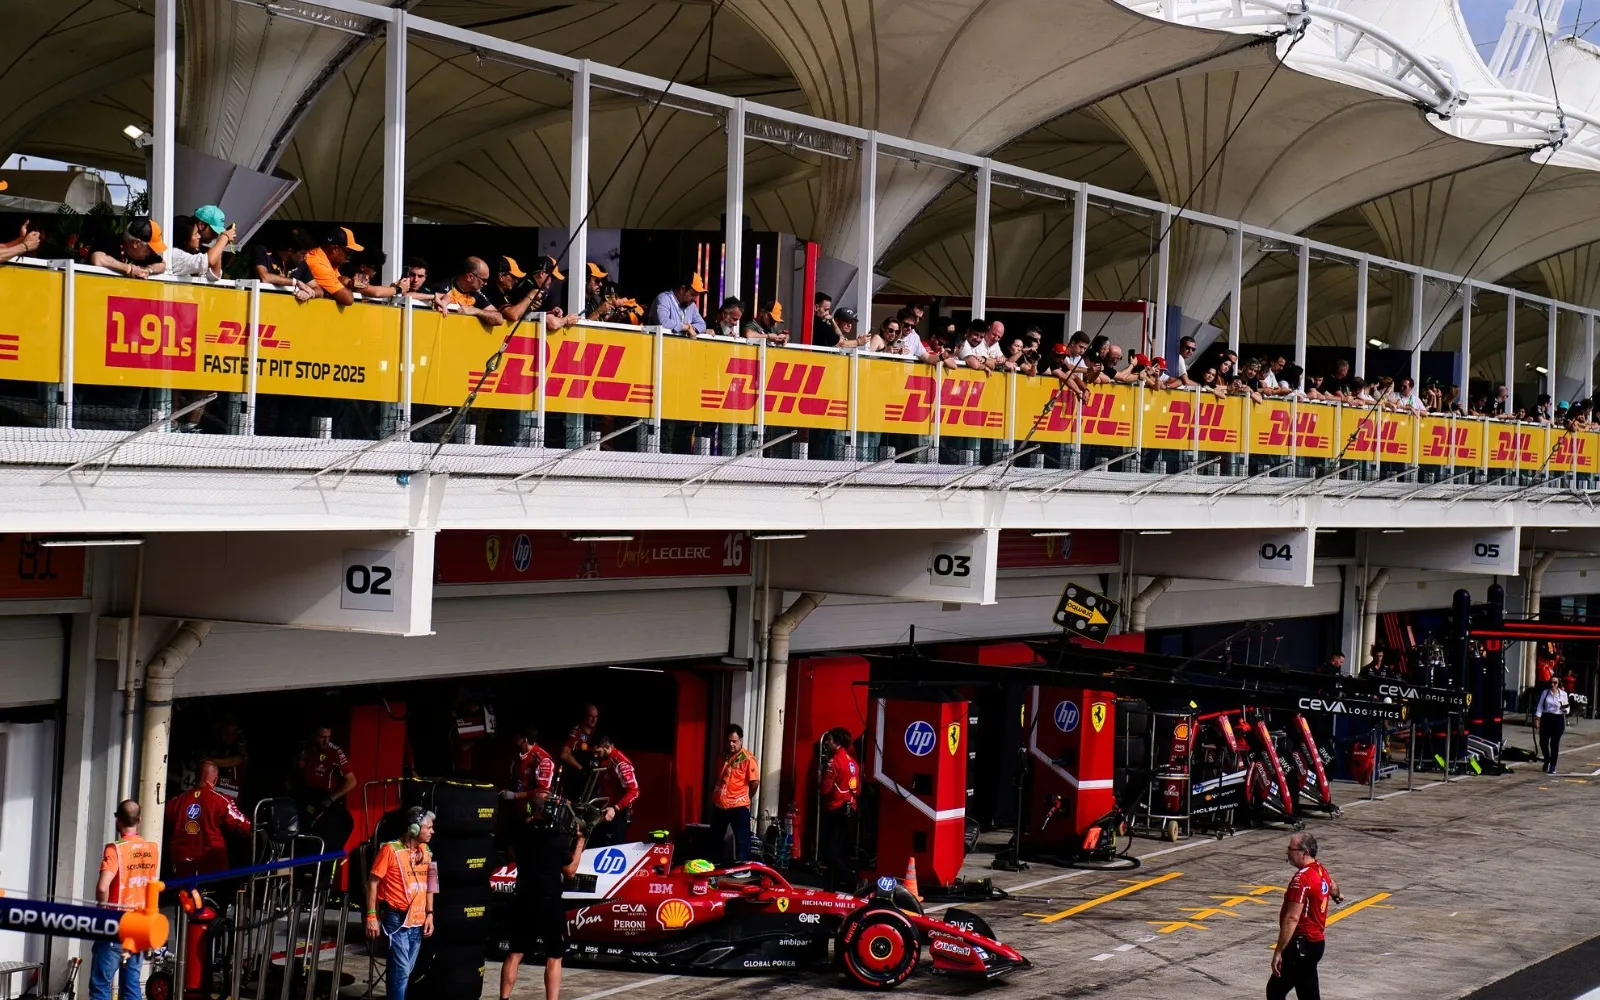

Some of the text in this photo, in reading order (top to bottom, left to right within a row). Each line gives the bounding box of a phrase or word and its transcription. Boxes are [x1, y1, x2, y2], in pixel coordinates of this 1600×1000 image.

[111, 311, 192, 357] 1.91s
[217, 321, 280, 348] DHL
[203, 354, 366, 383] FASTET PIT STOP 2025
[494, 334, 632, 400] DHL
[721, 358, 829, 415] DHL
[901, 375, 989, 426] DHL
[1045, 388, 1118, 434] DHL
[1167, 400, 1228, 442] DHL
[1268, 410, 1321, 448] DHL
[1355, 418, 1400, 454] DHL
[1430, 426, 1470, 459] DHL
[1497, 432, 1532, 463] DHL
[1556, 436, 1586, 466] DHL
[653, 547, 711, 560] LECLERC
[723, 533, 743, 566] 16
[1260, 543, 1293, 561] 04
[1474, 542, 1500, 558] 05
[933, 554, 970, 577] 03
[345, 564, 392, 595] 02
[1297, 697, 1348, 714] CEVA
[1422, 692, 1463, 706] LOGISICS
[1056, 702, 1078, 731] hp
[908, 722, 933, 754] hp
[187, 804, 200, 819] hp
[492, 866, 518, 878] 44
[597, 848, 625, 874] hp
[649, 883, 674, 894] IBM
[880, 877, 893, 890] hp
[611, 904, 647, 912] CEVA
[834, 900, 855, 909] MILLE
[8, 908, 120, 936] DP WORLD
[613, 919, 646, 928] PERONI
[779, 939, 808, 947] ambipar
[942, 942, 971, 956] UniCredit
